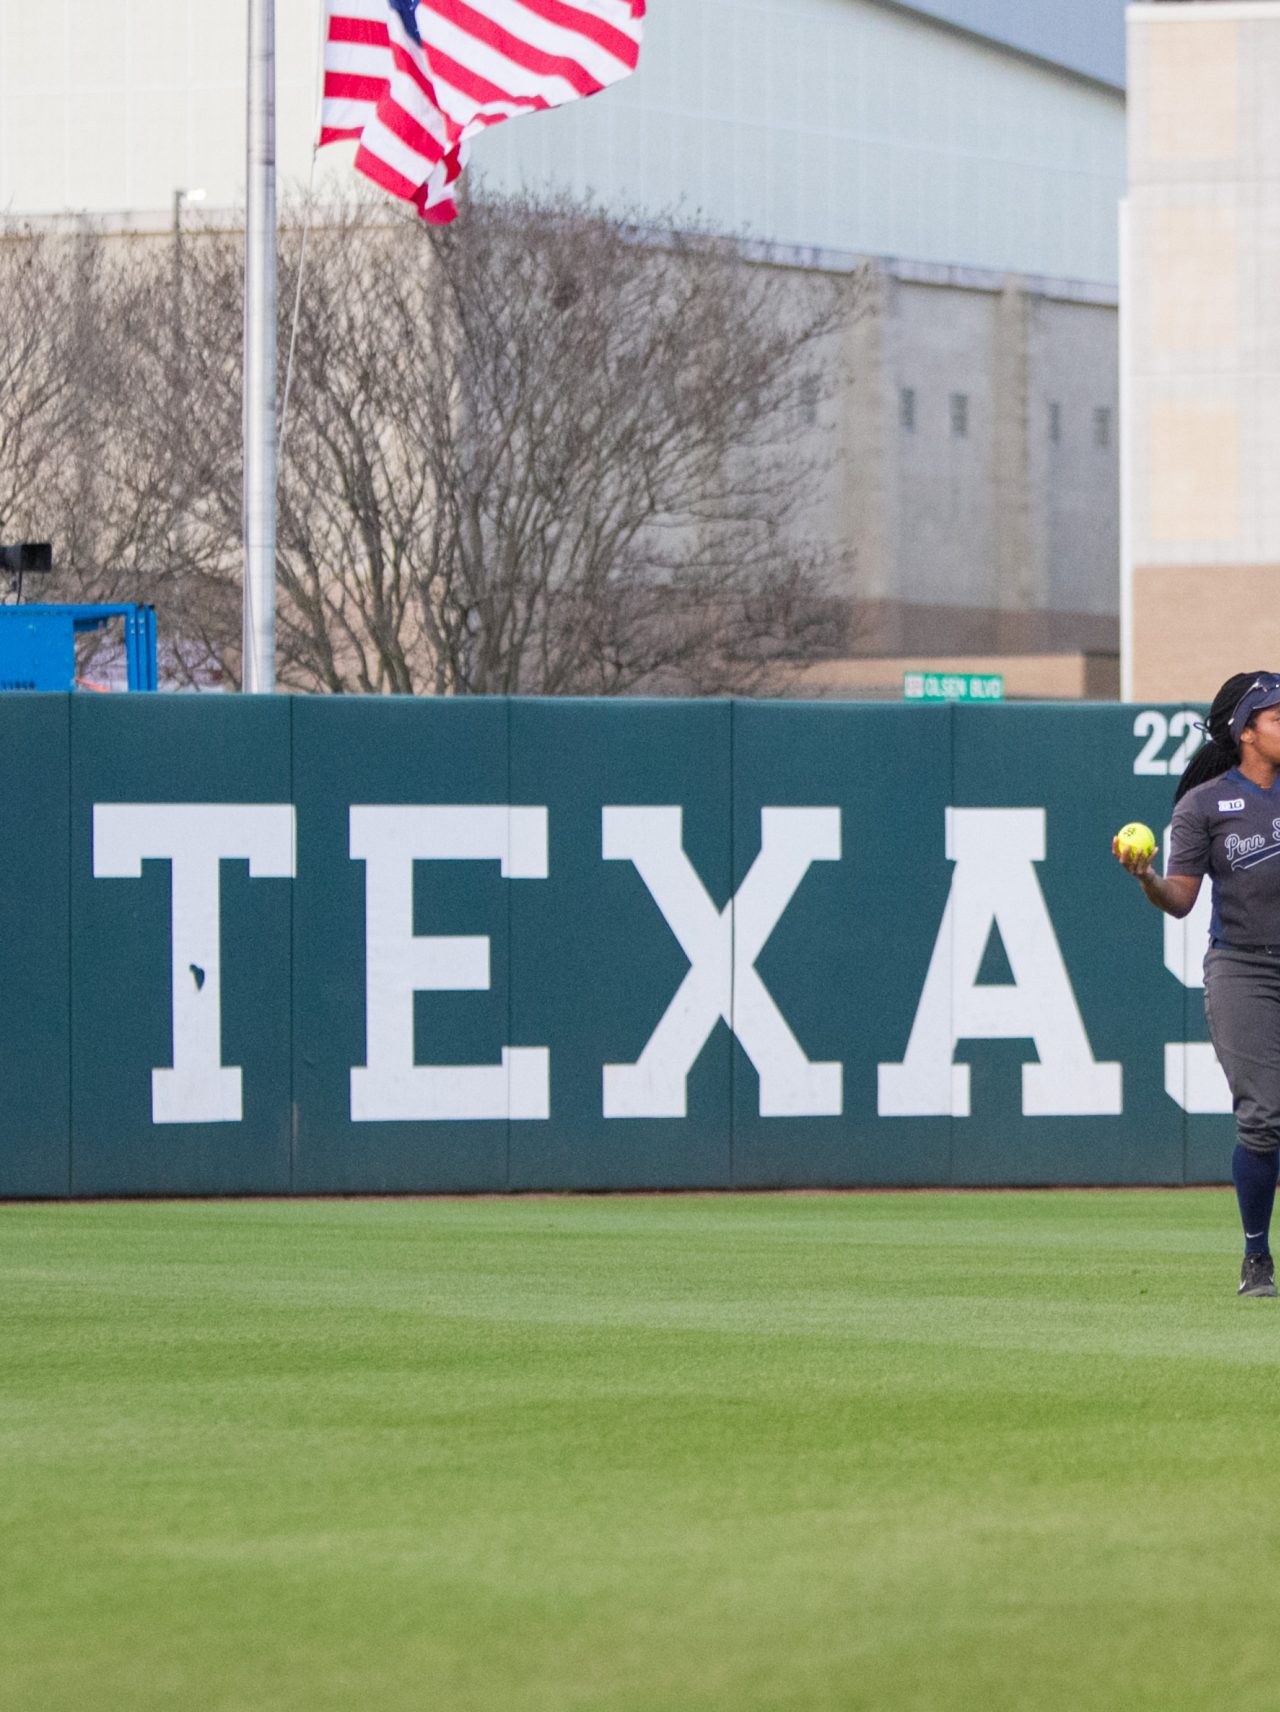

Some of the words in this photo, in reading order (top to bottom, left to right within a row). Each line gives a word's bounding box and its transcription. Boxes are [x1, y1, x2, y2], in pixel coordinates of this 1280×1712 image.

[925, 676, 967, 697] OLSEN
[969, 677, 1001, 699] BLVD
[1133, 710, 1213, 776] 22
[1224, 833, 1266, 861] Penn
